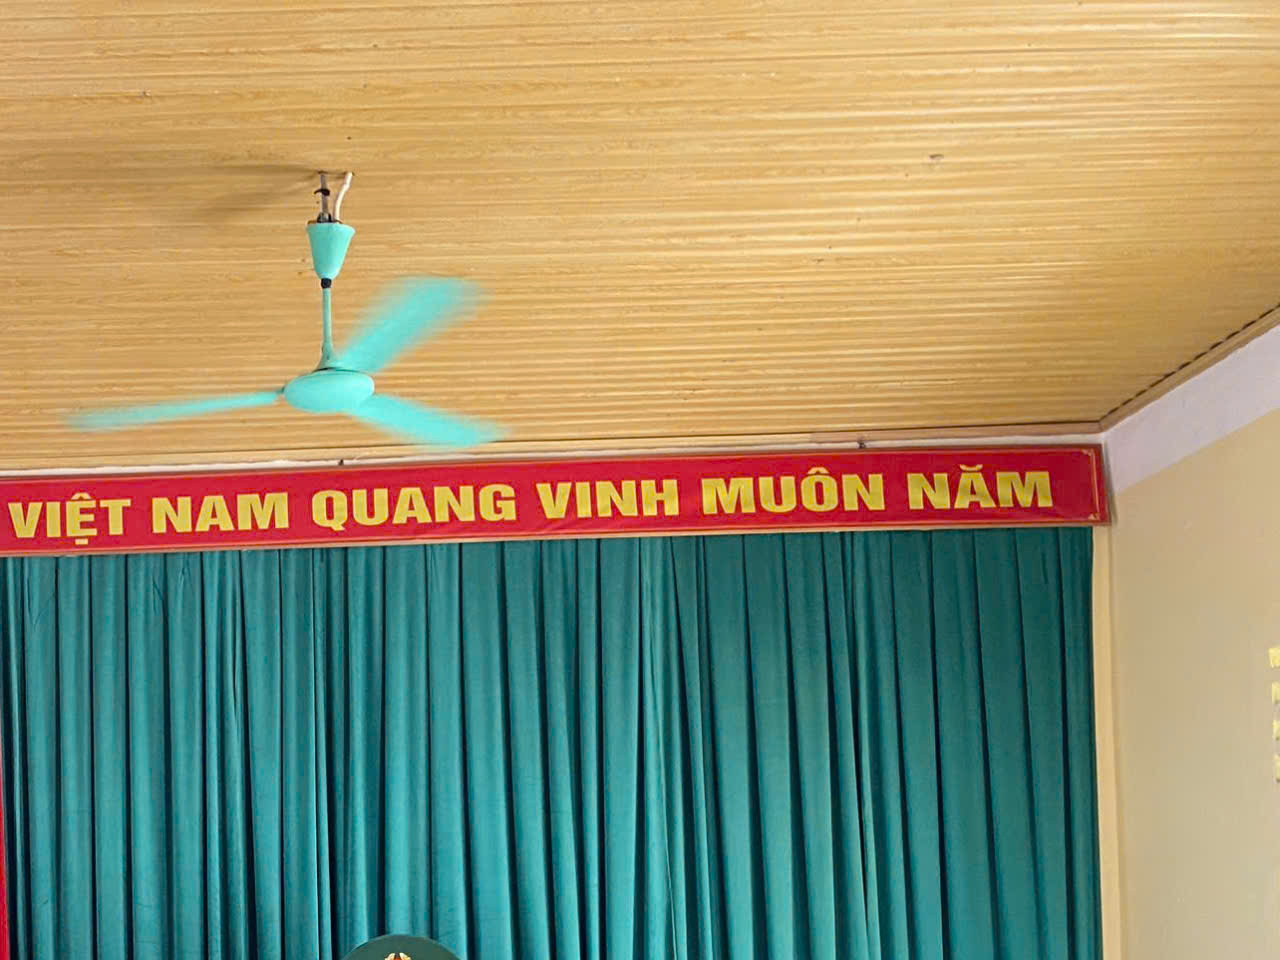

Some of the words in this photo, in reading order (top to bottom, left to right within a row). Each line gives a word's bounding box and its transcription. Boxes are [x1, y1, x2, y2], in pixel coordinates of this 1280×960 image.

[9, 492, 131, 547] VIỆT
[153, 493, 290, 532] NAM
[312, 486, 516, 531] QUANG
[536, 479, 679, 519] VINH
[702, 466, 885, 514] MUÔN
[907, 462, 1052, 509] NĂM
